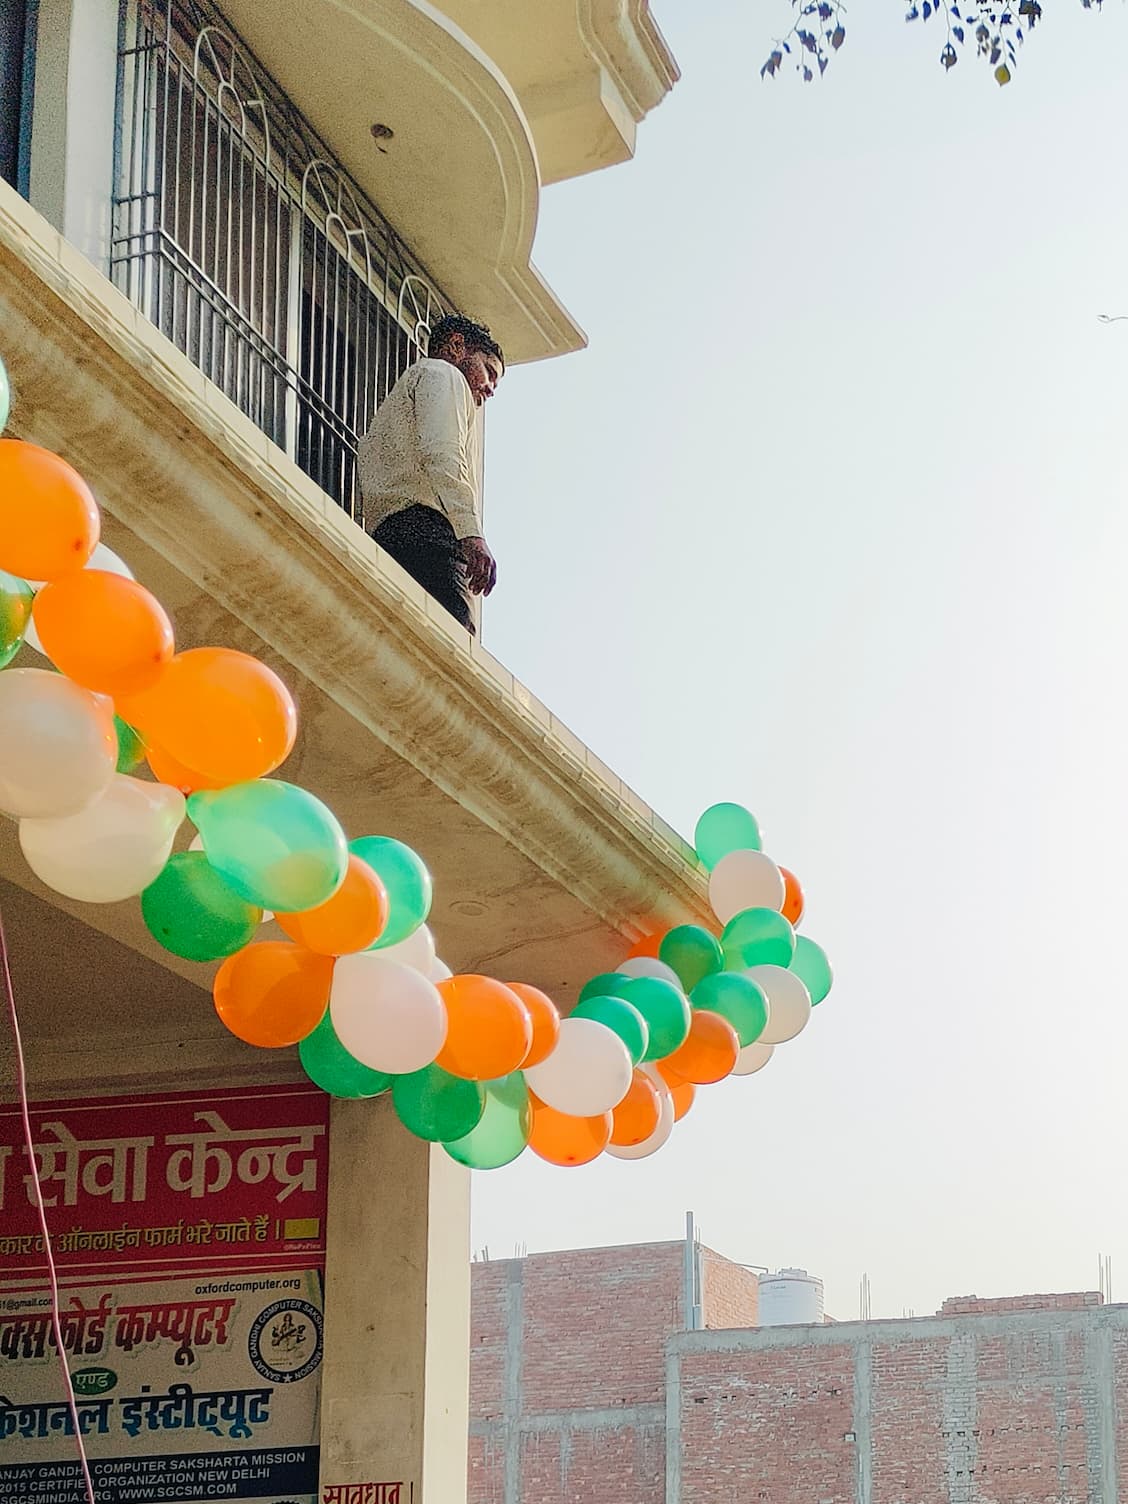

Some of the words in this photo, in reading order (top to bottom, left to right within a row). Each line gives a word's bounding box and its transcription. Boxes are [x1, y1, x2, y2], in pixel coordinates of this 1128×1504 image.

[22, 1121, 154, 1207] सेवा
[165, 1111, 326, 1203] केन्द्र
[186, 1219, 214, 1244] भरे
[214, 1217, 252, 1242] जाते
[195, 1279, 301, 1295] oxfordcomputer.org
[259, 1301, 302, 1323] COMPUTER
[115, 1298, 237, 1366] कम्प्यूटर
[39, 1465, 86, 1479] GANDH
[94, 1461, 167, 1475] COMPUTER
[170, 1456, 249, 1470] SAKSHARTA
[252, 1452, 306, 1465] MISSION
[0, 1482, 27, 1494] 2015
[98, 1472, 195, 1488] ORGANIZATION
[199, 1470, 229, 1482] NEW
[232, 1468, 270, 1480] DELHI
[118, 1483, 237, 1500] WWW.SGCSM.COM
